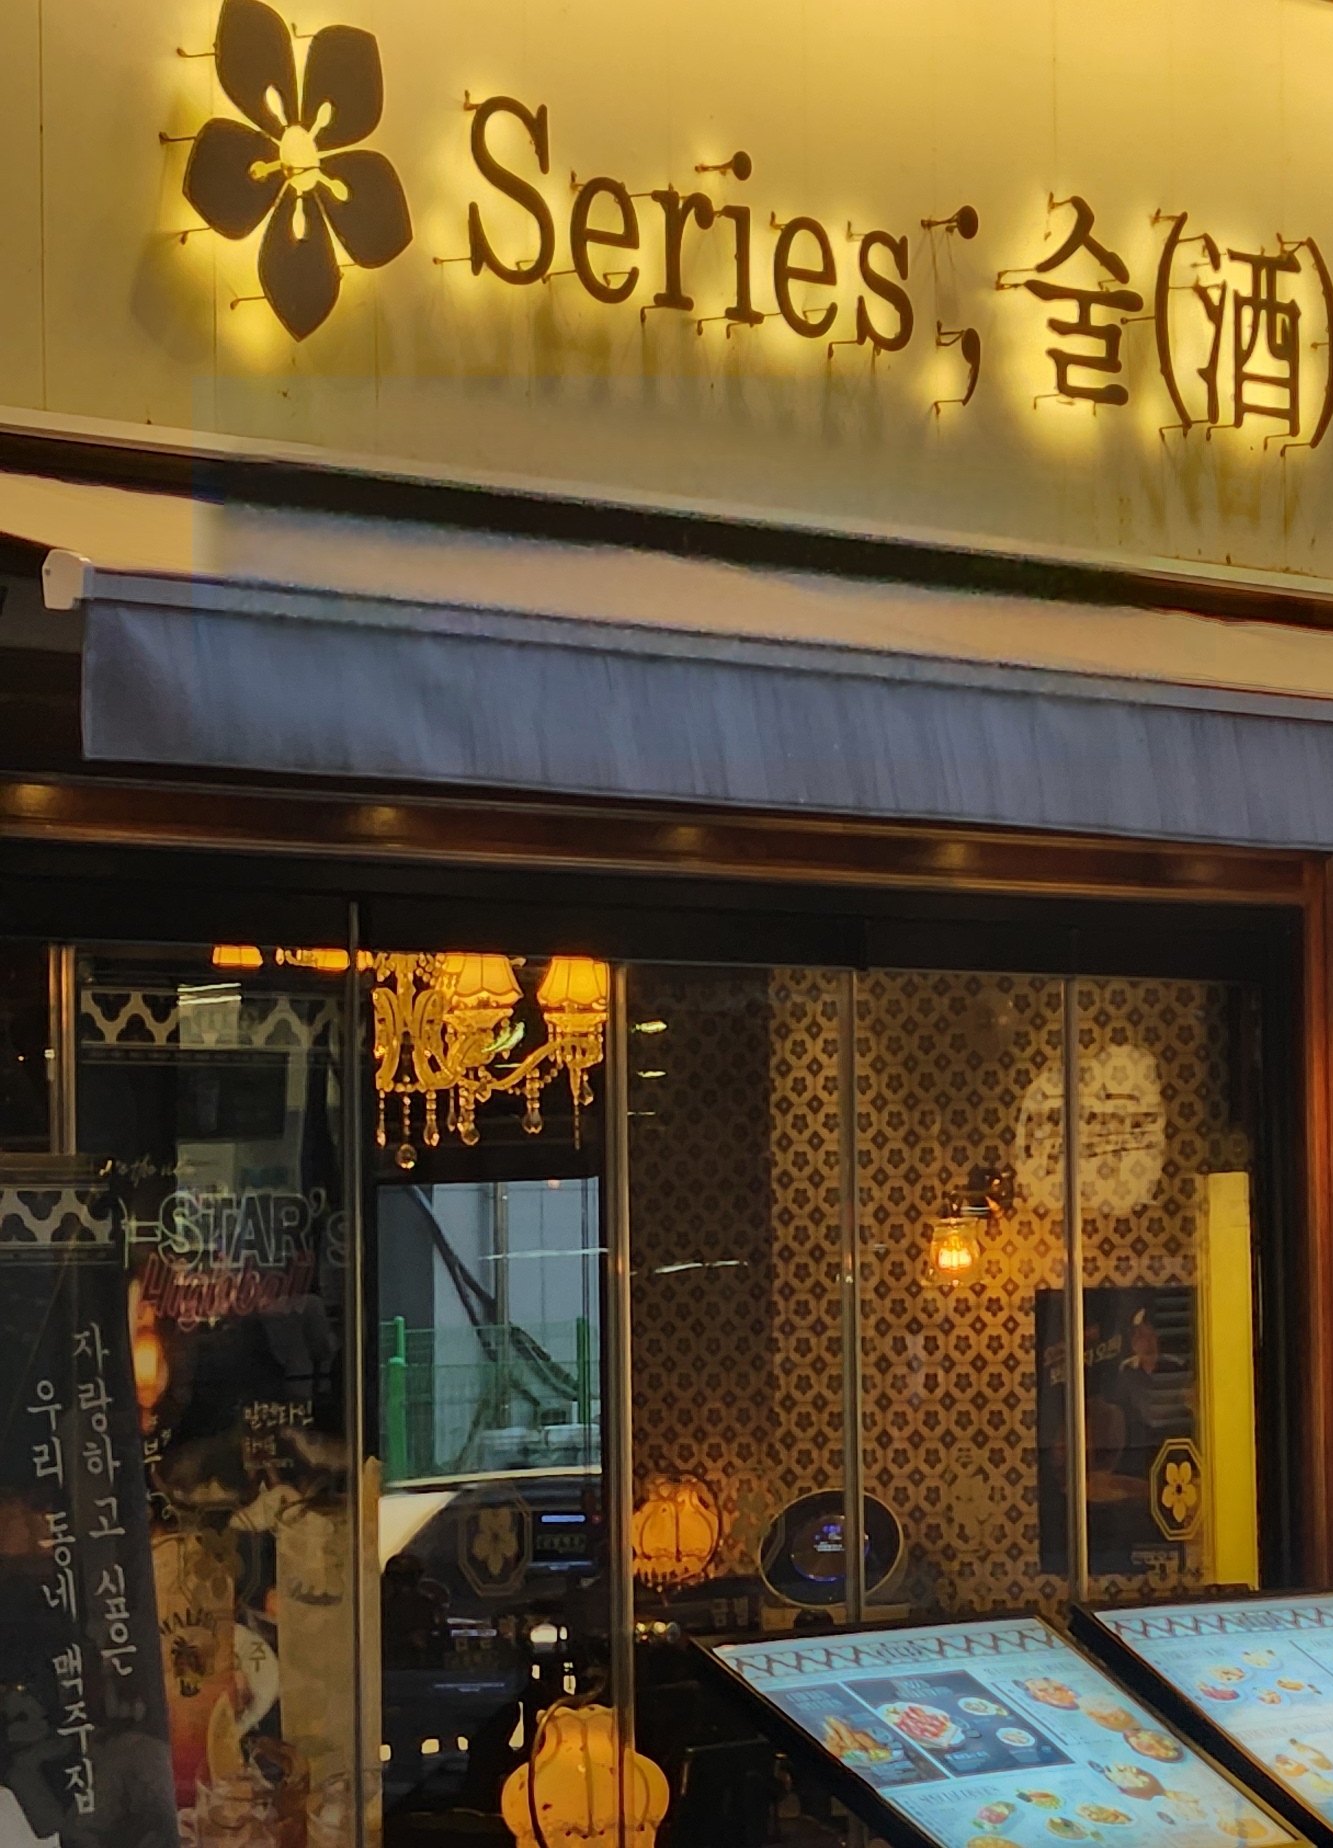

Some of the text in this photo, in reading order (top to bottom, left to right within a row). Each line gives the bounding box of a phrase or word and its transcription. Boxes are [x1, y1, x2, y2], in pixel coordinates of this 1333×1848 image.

[27, 1379, 96, 1814] 우리 동네 맥주집
[73, 1321, 137, 1676] 자랑하고 싶은
